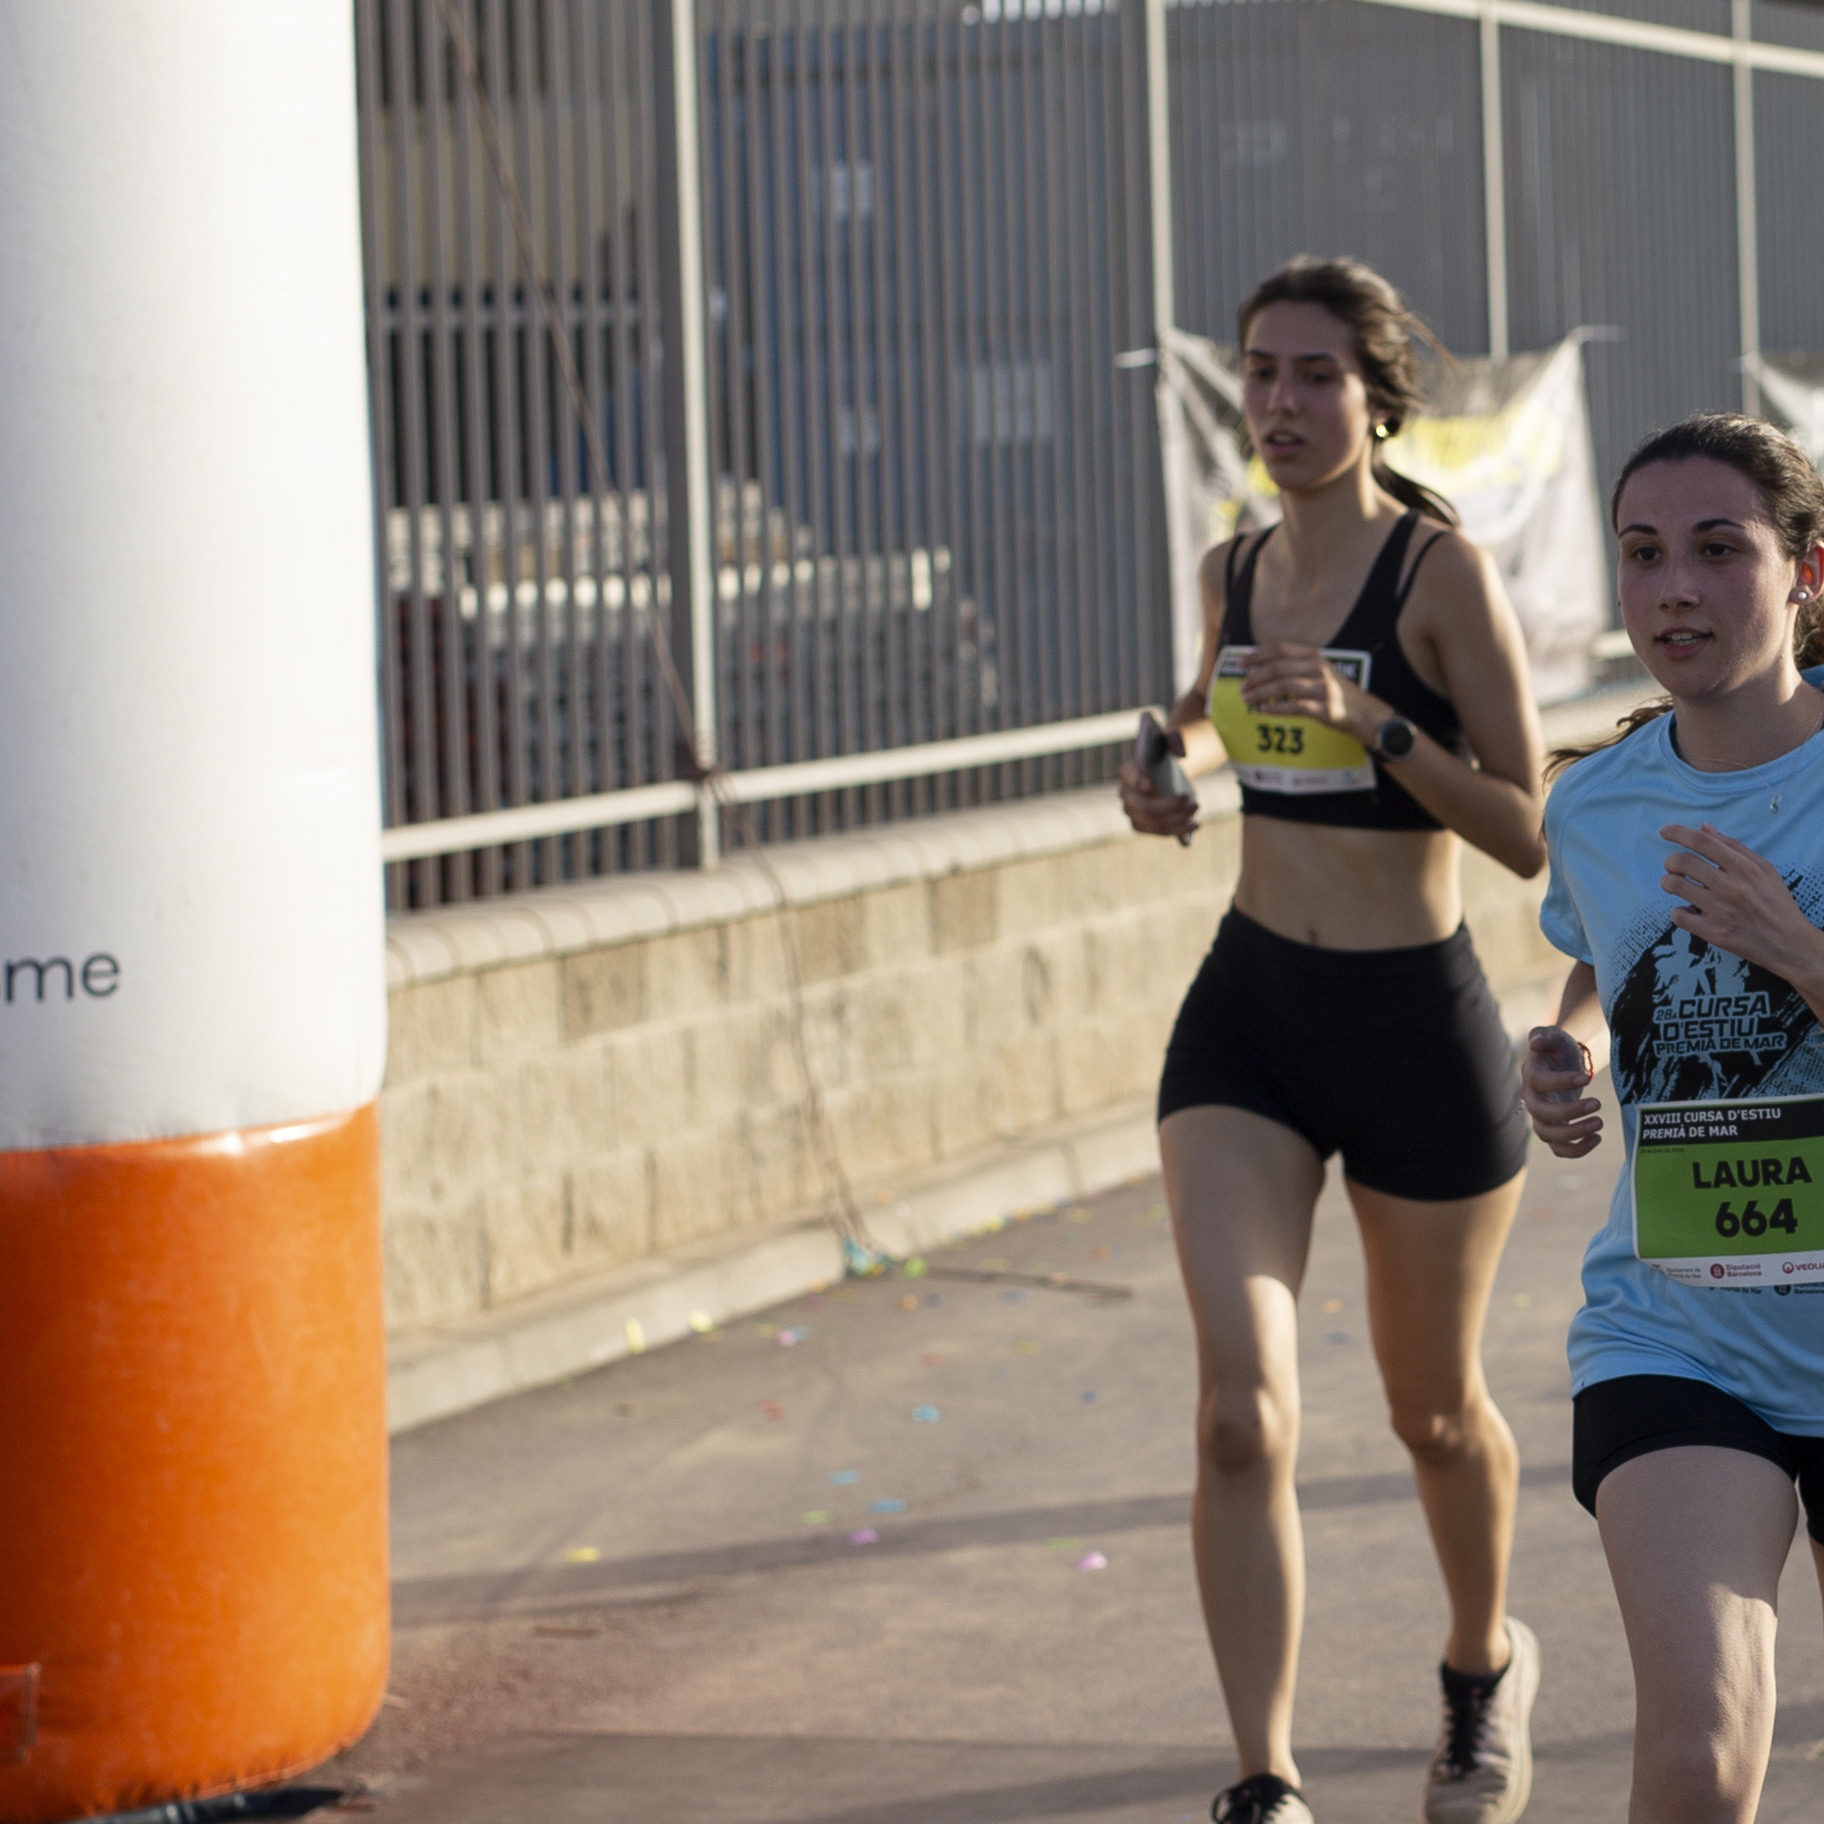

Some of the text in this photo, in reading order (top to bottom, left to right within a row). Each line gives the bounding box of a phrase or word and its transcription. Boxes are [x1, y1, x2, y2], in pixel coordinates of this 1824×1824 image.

[1257, 724, 1305, 754] 323
[4, 952, 120, 1004] me
[1679, 996, 1768, 1018] CURSA
[1664, 1017, 1755, 1041] D'ESTIU
[1720, 1037, 1741, 1048] DE
[1744, 1035, 1784, 1050] MAR
[1643, 1107, 1782, 1125] XXVIII CURSA D'ESTIU
[1642, 1124, 1738, 1140] PREMIÀ DE MAR
[1692, 1156, 1813, 1190] LAURA
[1715, 1198, 1799, 1238] 664
